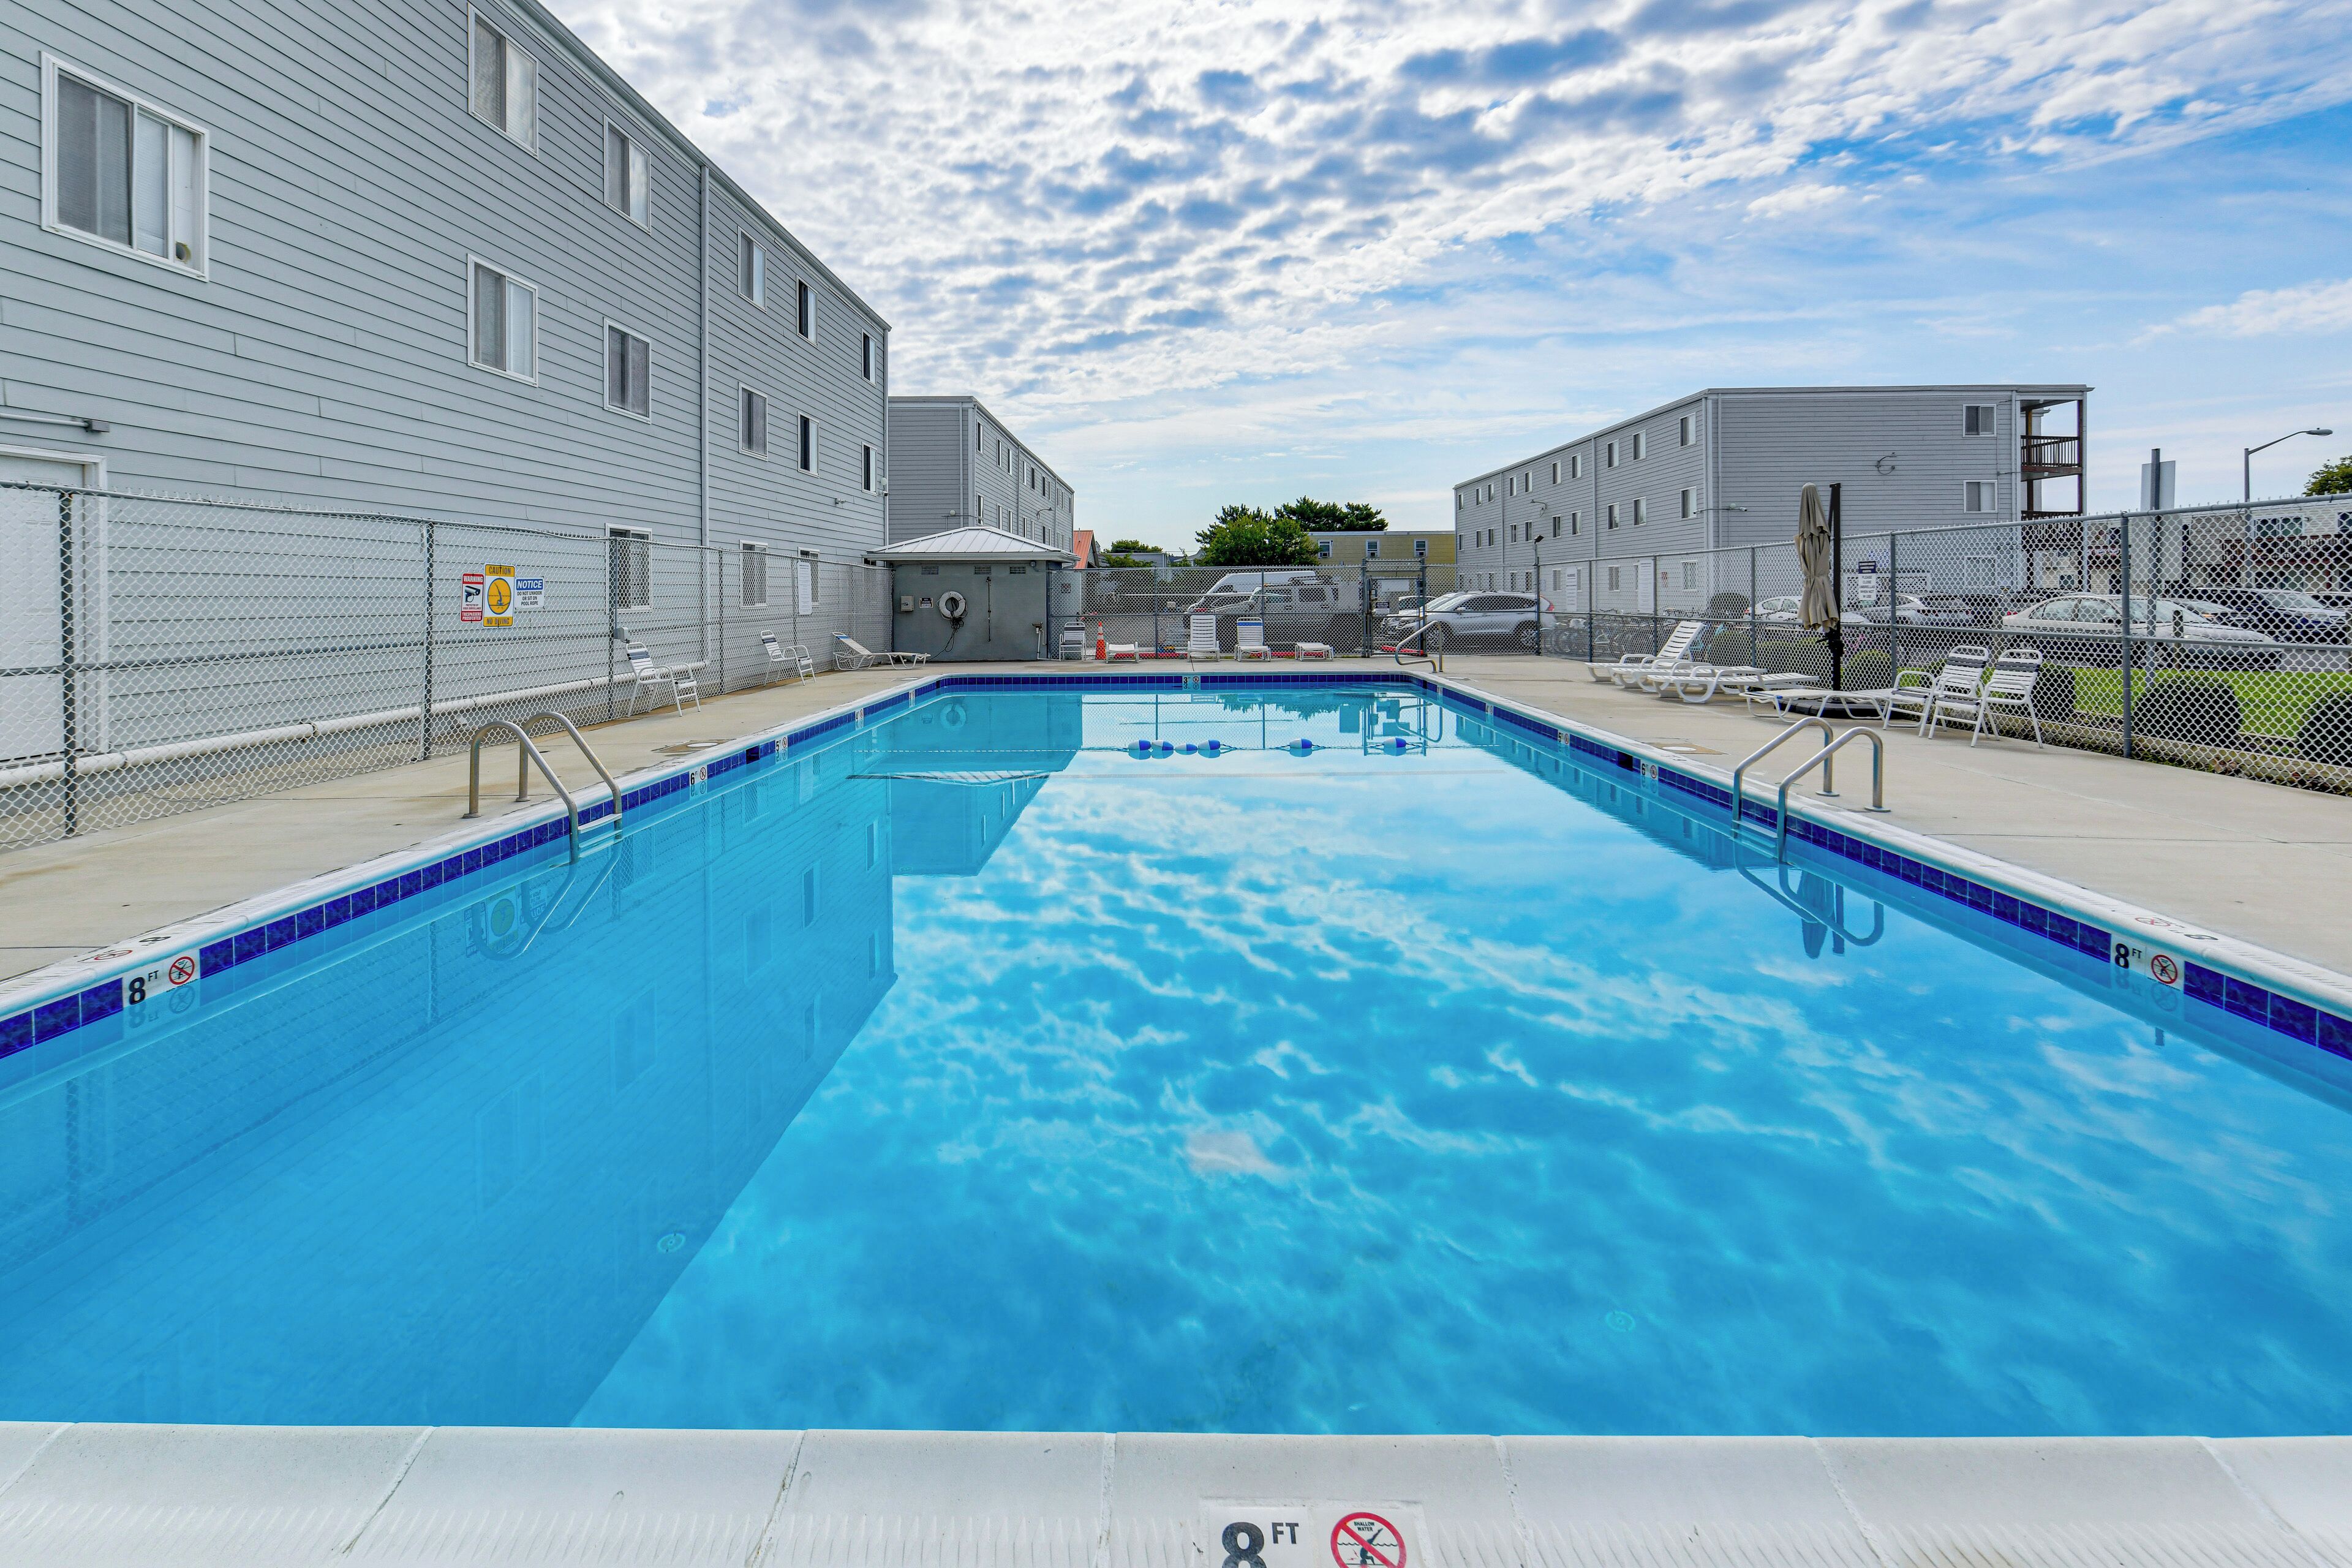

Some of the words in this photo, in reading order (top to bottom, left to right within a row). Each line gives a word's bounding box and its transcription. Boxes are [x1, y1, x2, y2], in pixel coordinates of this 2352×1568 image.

[489, 566, 511, 575] CAUTION
[517, 580, 543, 589] NOTICE
[776, 741, 780, 752] 5
[1642, 763, 1646, 775] 6
[690, 772, 695, 785] 6
[2114, 943, 2130, 969] 8
[2132, 948, 2143, 959] FT
[129, 976, 146, 1006] 8
[148, 970, 159, 982] FT
[1221, 1521, 1267, 1568] 8
[1272, 1522, 1299, 1544] FT
